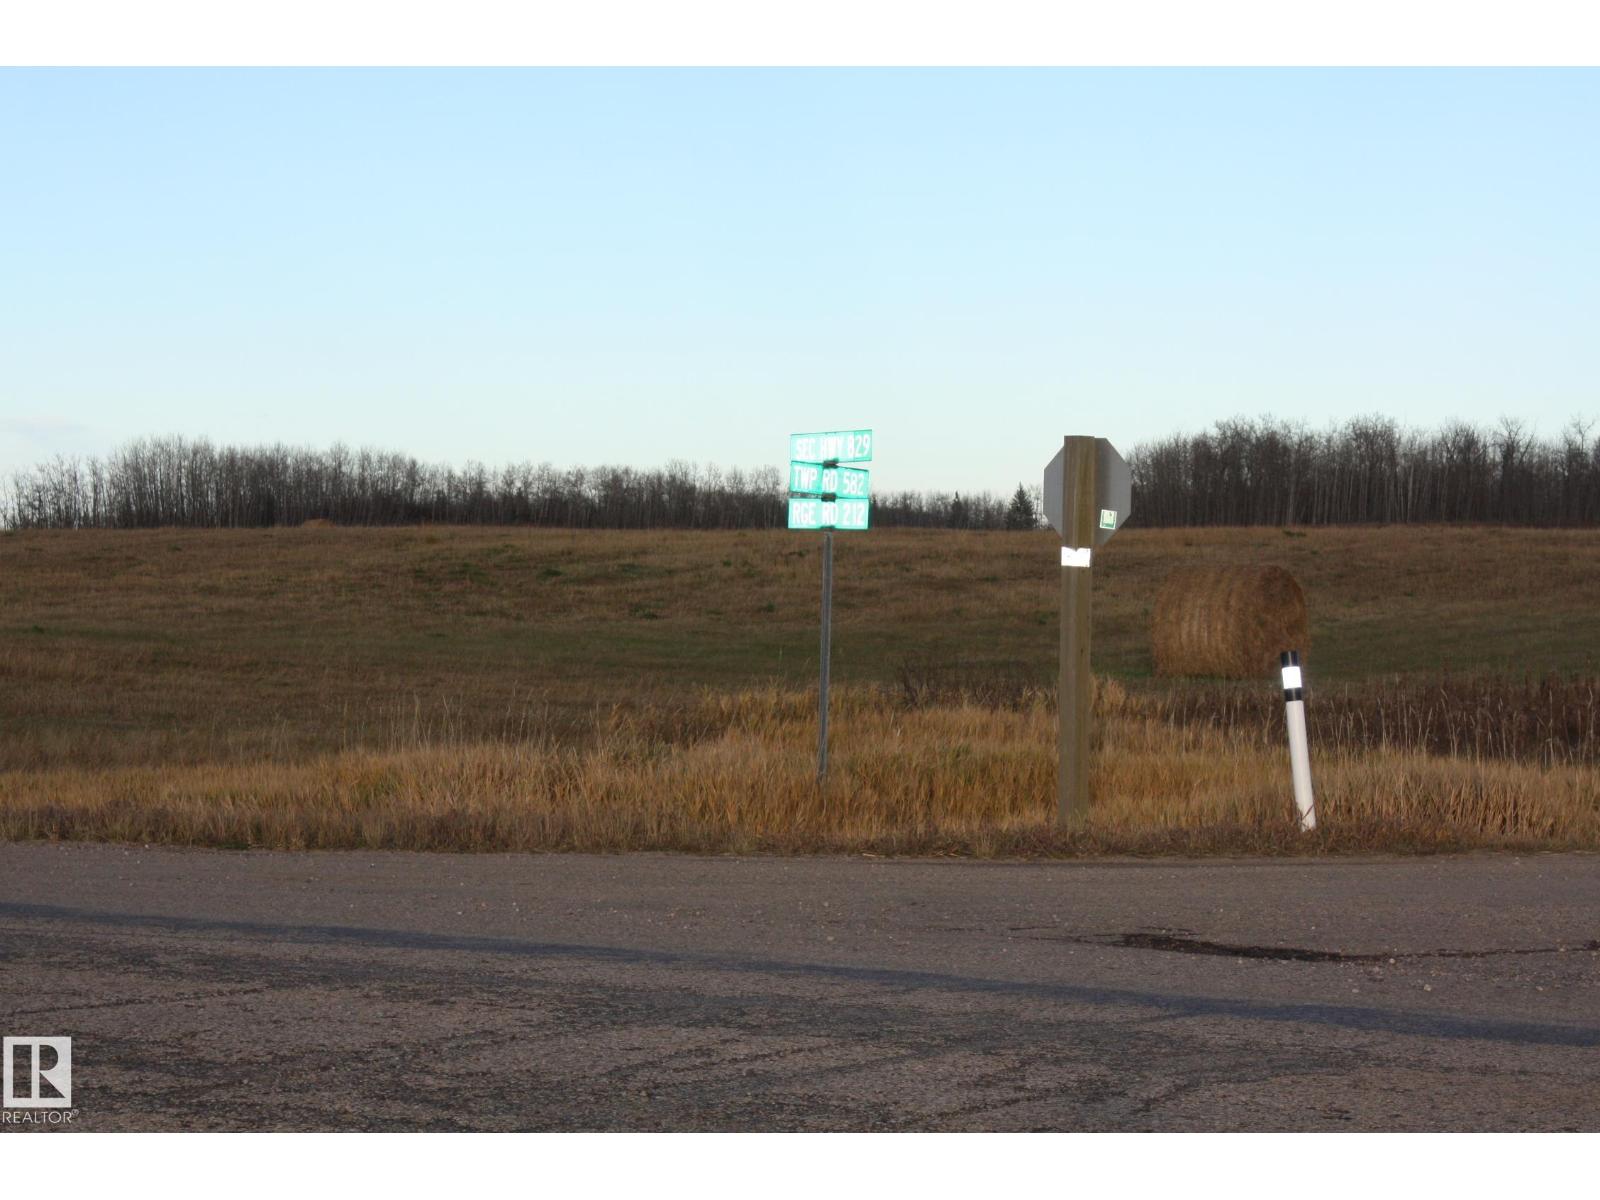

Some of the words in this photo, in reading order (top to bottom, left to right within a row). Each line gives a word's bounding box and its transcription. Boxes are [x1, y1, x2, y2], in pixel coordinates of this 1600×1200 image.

[794, 467, 817, 490] TWP
[822, 469, 837, 492] RD
[843, 472, 865, 495] 582
[793, 502, 816, 525] RGE
[822, 502, 838, 525] RD
[843, 502, 865, 524] 212
